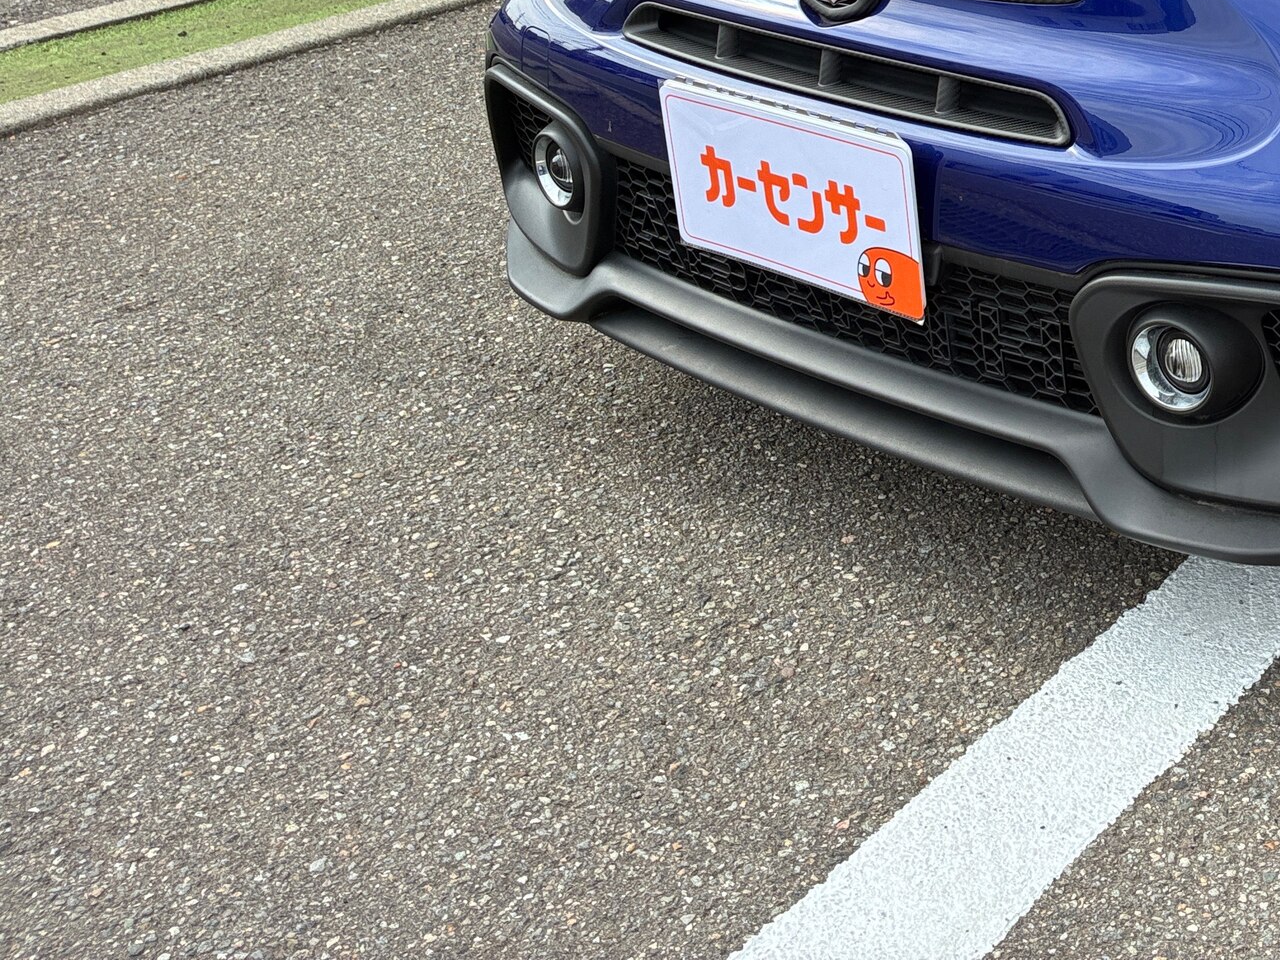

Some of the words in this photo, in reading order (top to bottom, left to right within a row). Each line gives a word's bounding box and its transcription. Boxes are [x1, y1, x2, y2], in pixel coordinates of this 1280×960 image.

[700, 145, 886, 245] カーセンサー
